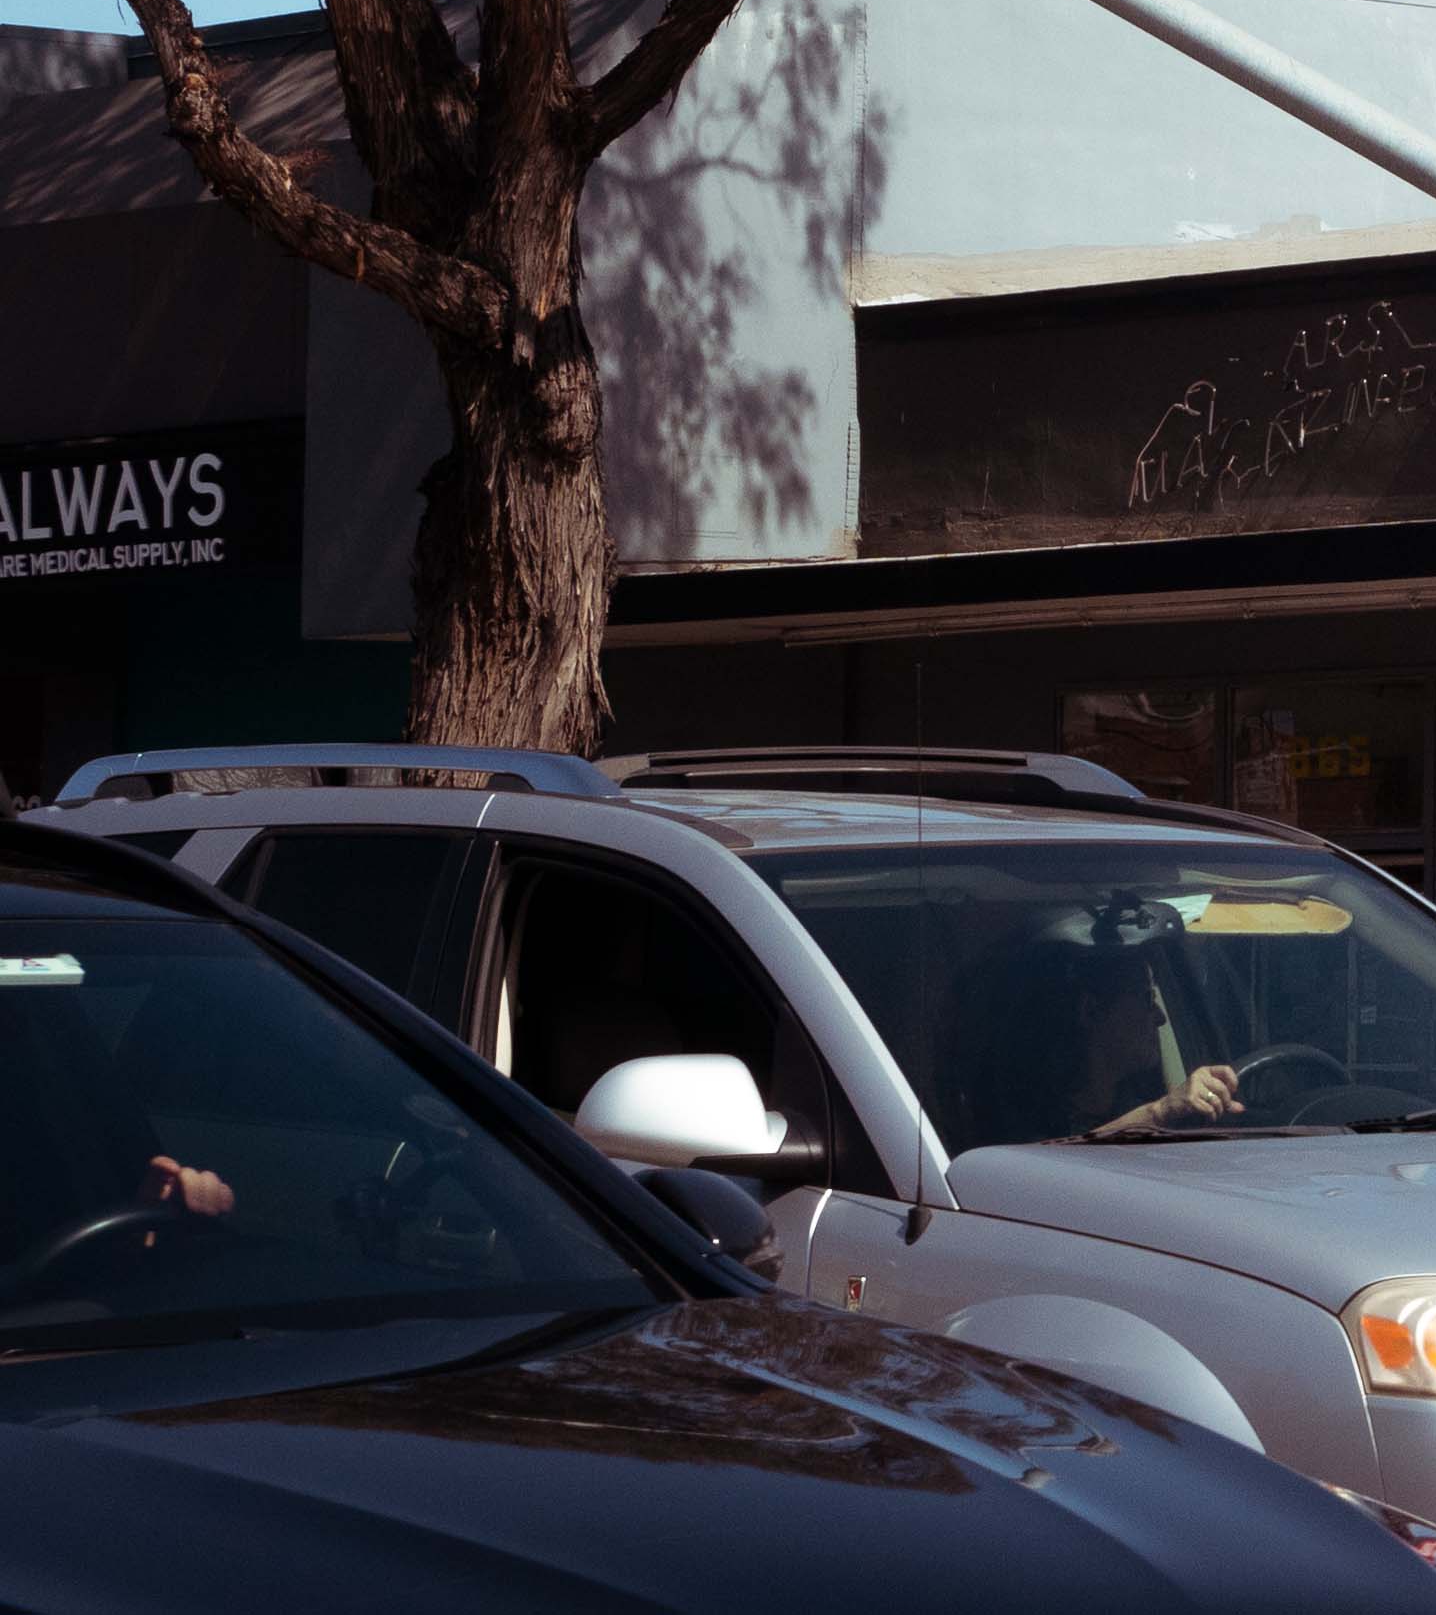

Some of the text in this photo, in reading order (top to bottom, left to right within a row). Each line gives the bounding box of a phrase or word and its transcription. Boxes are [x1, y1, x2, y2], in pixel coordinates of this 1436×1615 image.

[29, 547, 112, 576] MEDICAL
[112, 539, 190, 569] SUPPLY,
[191, 537, 227, 563] INC
